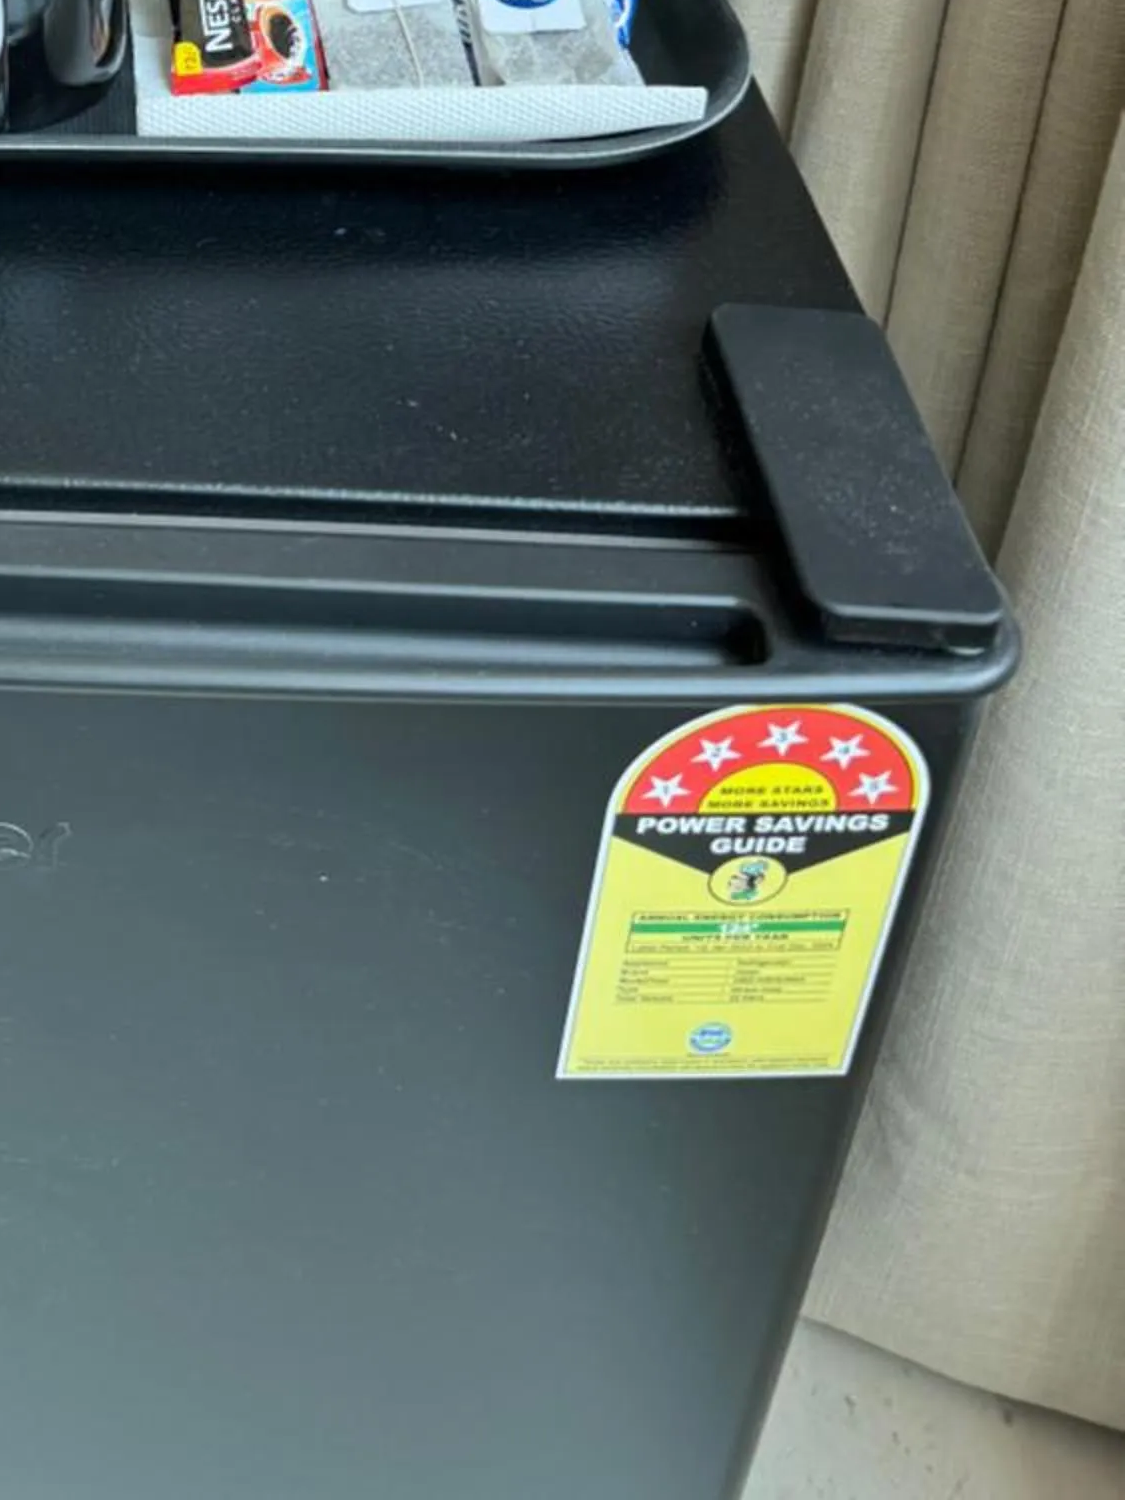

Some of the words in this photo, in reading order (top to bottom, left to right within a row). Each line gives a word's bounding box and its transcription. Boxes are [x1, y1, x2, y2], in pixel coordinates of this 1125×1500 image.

[720, 786, 765, 795] MORE
[771, 785, 823, 795] STARS
[707, 800, 752, 808] MORE
[758, 798, 829, 808] SAVINGS
[636, 815, 747, 834] POWER
[753, 813, 890, 833] SAVINGS
[709, 836, 808, 854] GUIDE
